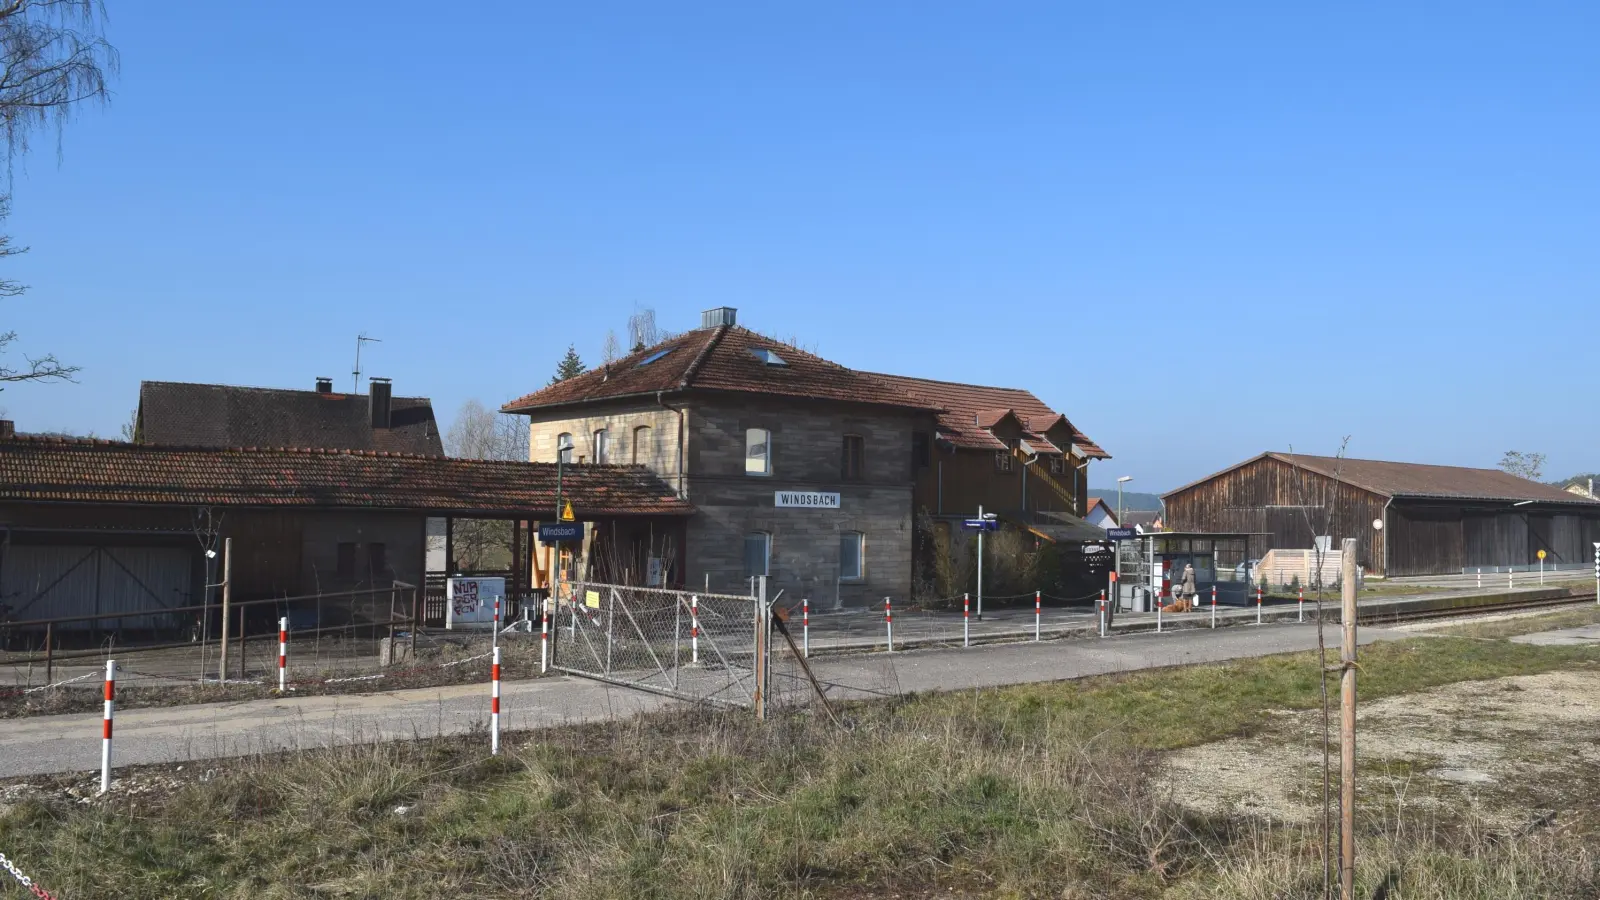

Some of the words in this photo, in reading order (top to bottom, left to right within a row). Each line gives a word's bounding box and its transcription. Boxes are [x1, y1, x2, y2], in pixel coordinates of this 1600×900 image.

[781, 493, 836, 506] WINDSBACH
[542, 527, 576, 537] Windsbach
[1108, 529, 1132, 537] Windsbach
